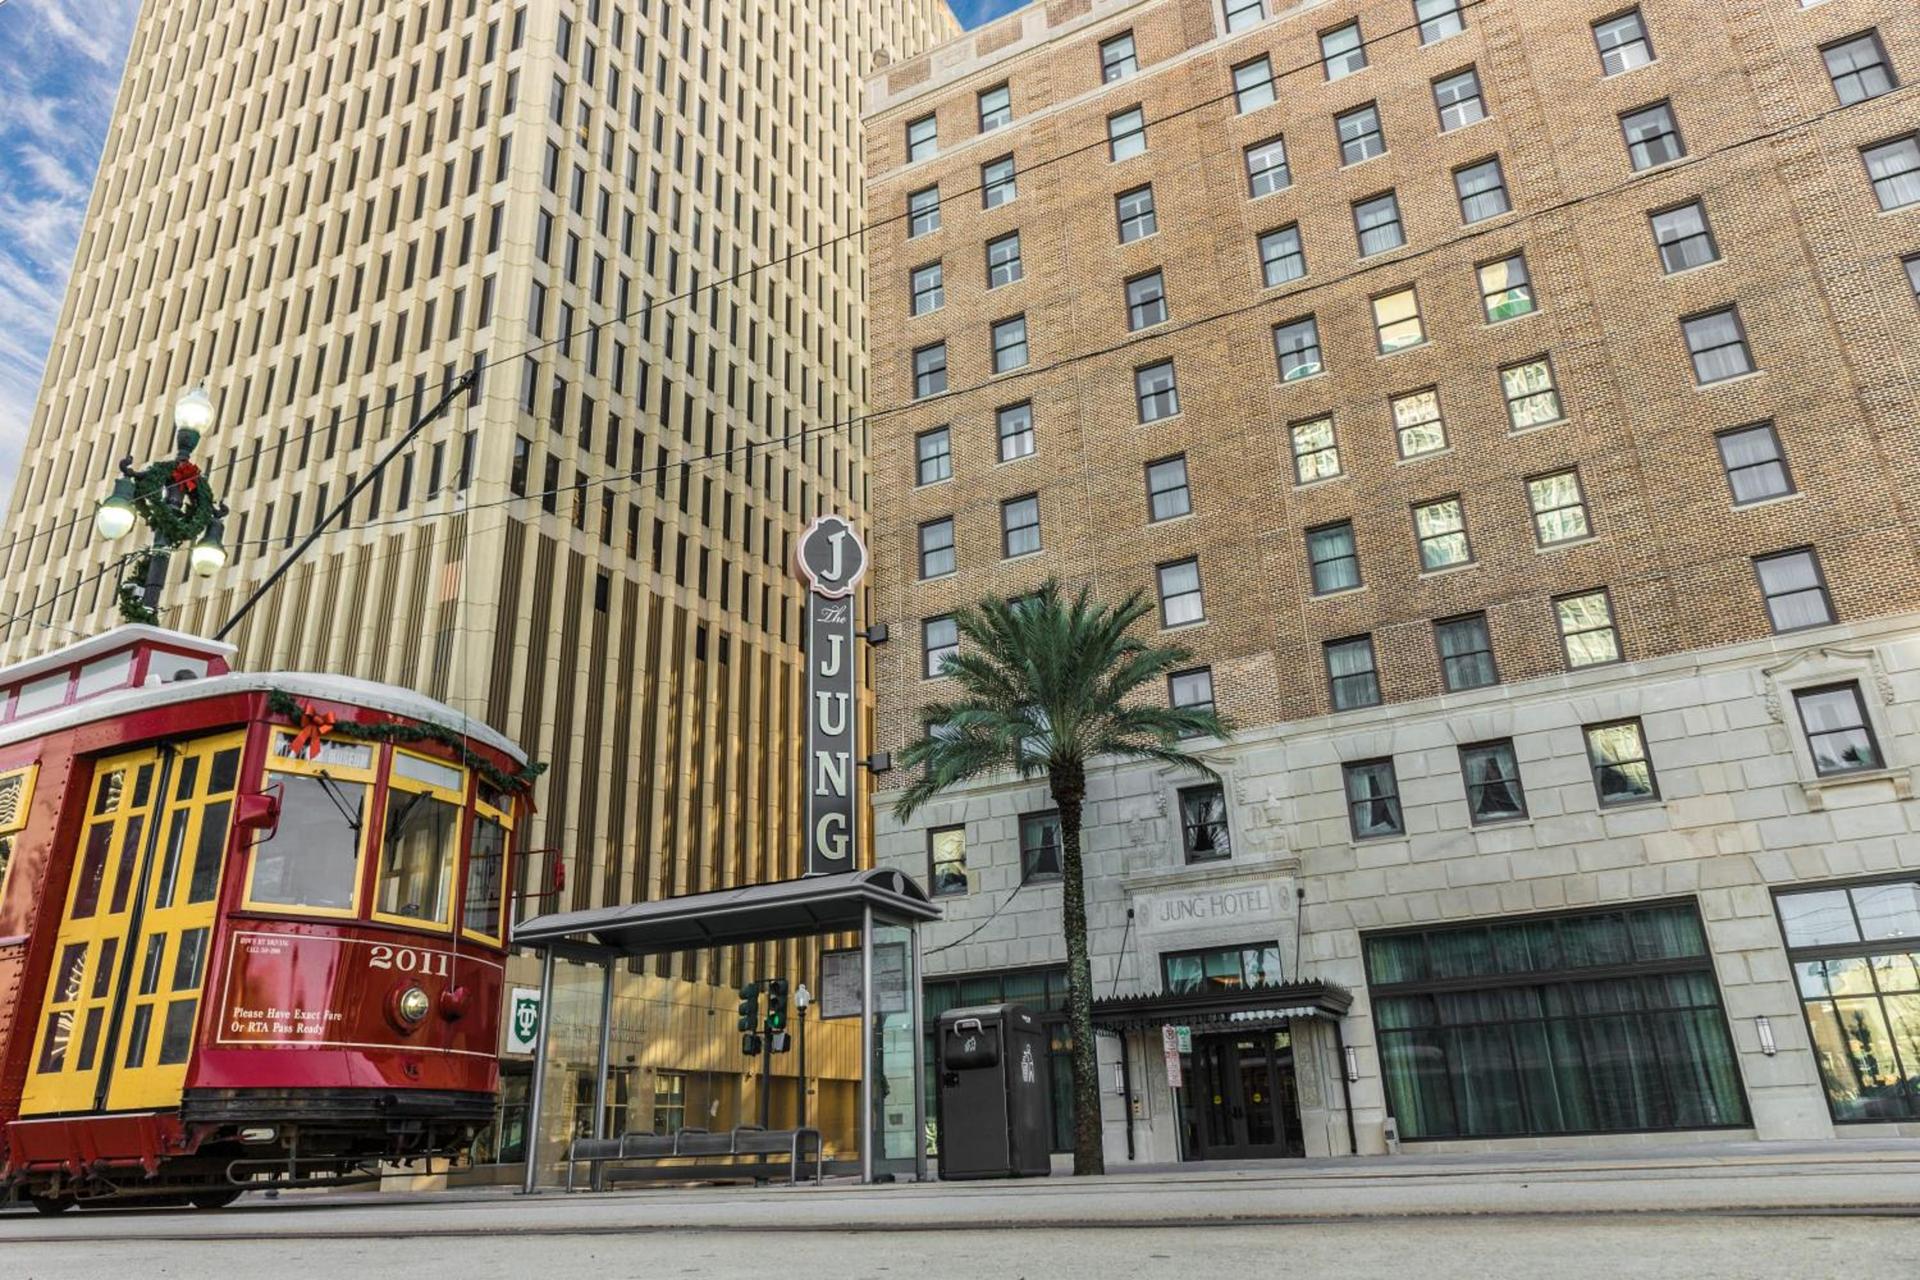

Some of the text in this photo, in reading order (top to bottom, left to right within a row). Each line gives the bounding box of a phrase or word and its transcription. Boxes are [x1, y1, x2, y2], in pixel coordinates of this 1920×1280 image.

[820, 530, 846, 581] J
[816, 605, 847, 625] The
[815, 633, 850, 860] JUNG
[1160, 890, 1270, 922] JUNG HOTEL
[369, 946, 449, 977] 2011
[231, 1021, 324, 1035] Or RTA Pass Ready
[233, 1007, 342, 1021] Please Have Exact Fare
